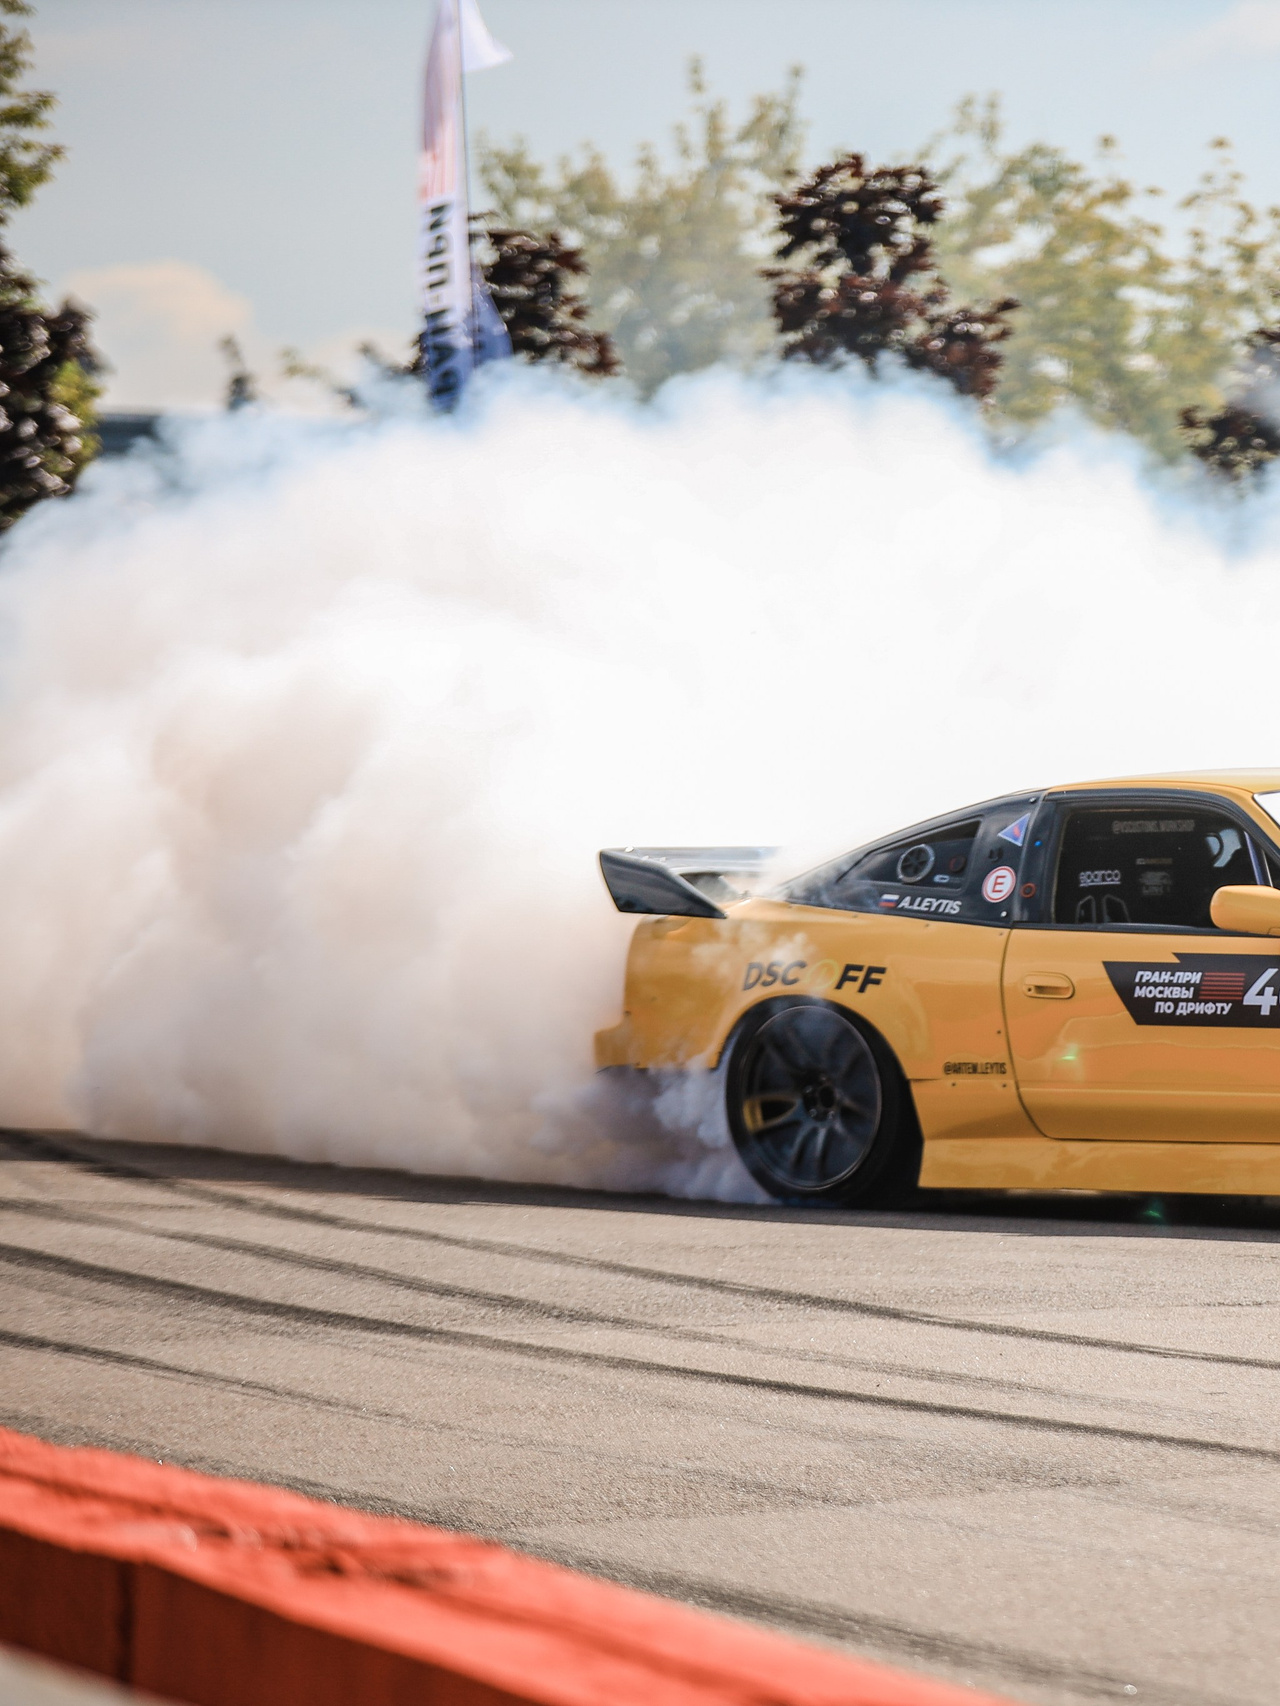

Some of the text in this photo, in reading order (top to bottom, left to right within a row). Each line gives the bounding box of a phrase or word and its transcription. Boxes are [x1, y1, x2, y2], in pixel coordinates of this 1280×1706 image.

[991, 875, 1007, 893] E
[897, 896, 962, 914] A.LEYTIS
[1134, 970, 1202, 984] ГРАН-ПРИ
[1133, 985, 1194, 998] МОСКВЫ
[1154, 1001, 1232, 1016] ПО ДРИФТУ
